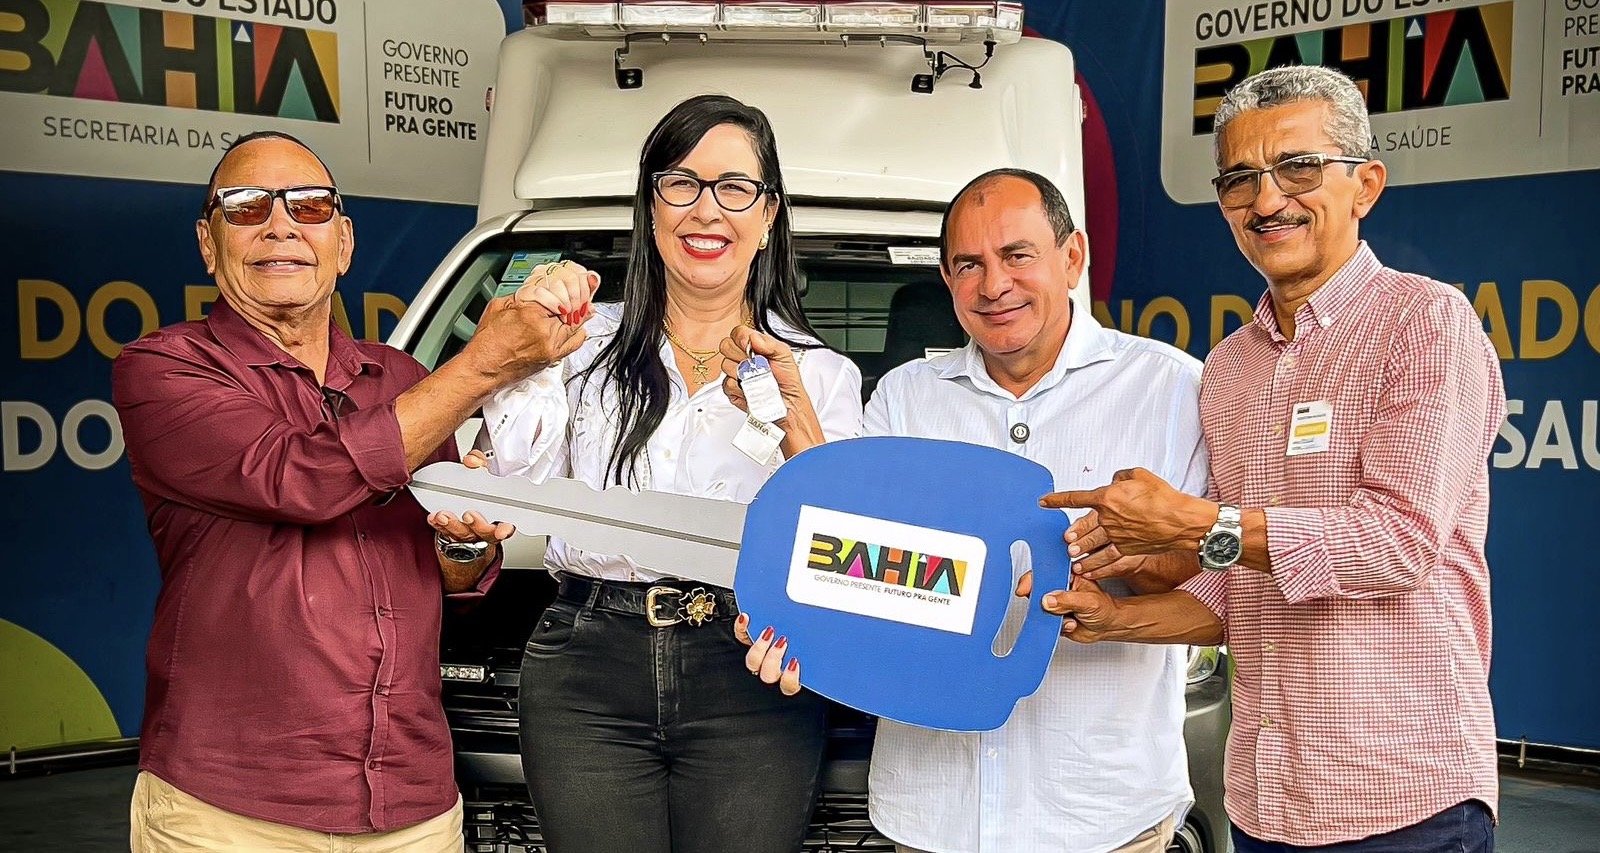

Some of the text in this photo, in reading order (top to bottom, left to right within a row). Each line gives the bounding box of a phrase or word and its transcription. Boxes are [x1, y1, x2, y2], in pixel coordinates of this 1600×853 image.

[1195, 0, 1332, 41] GOVERNO
[1564, 14, 1599, 38] PRE
[383, 39, 469, 67] GOVERNO
[384, 62, 460, 89] PRESENTE
[385, 91, 453, 116] FUTURO
[43, 116, 180, 147] SECRETARIA
[187, 129, 215, 150] DA
[385, 113, 477, 141] PRA GENTE
[1385, 125, 1452, 152] SAÚDE
[17, 279, 160, 360] DO
[1, 399, 126, 472] DO
[807, 532, 968, 597] BAHIA
[814, 574, 951, 606] GOVERNO PRESENTE FUTURO PRA GENTE
